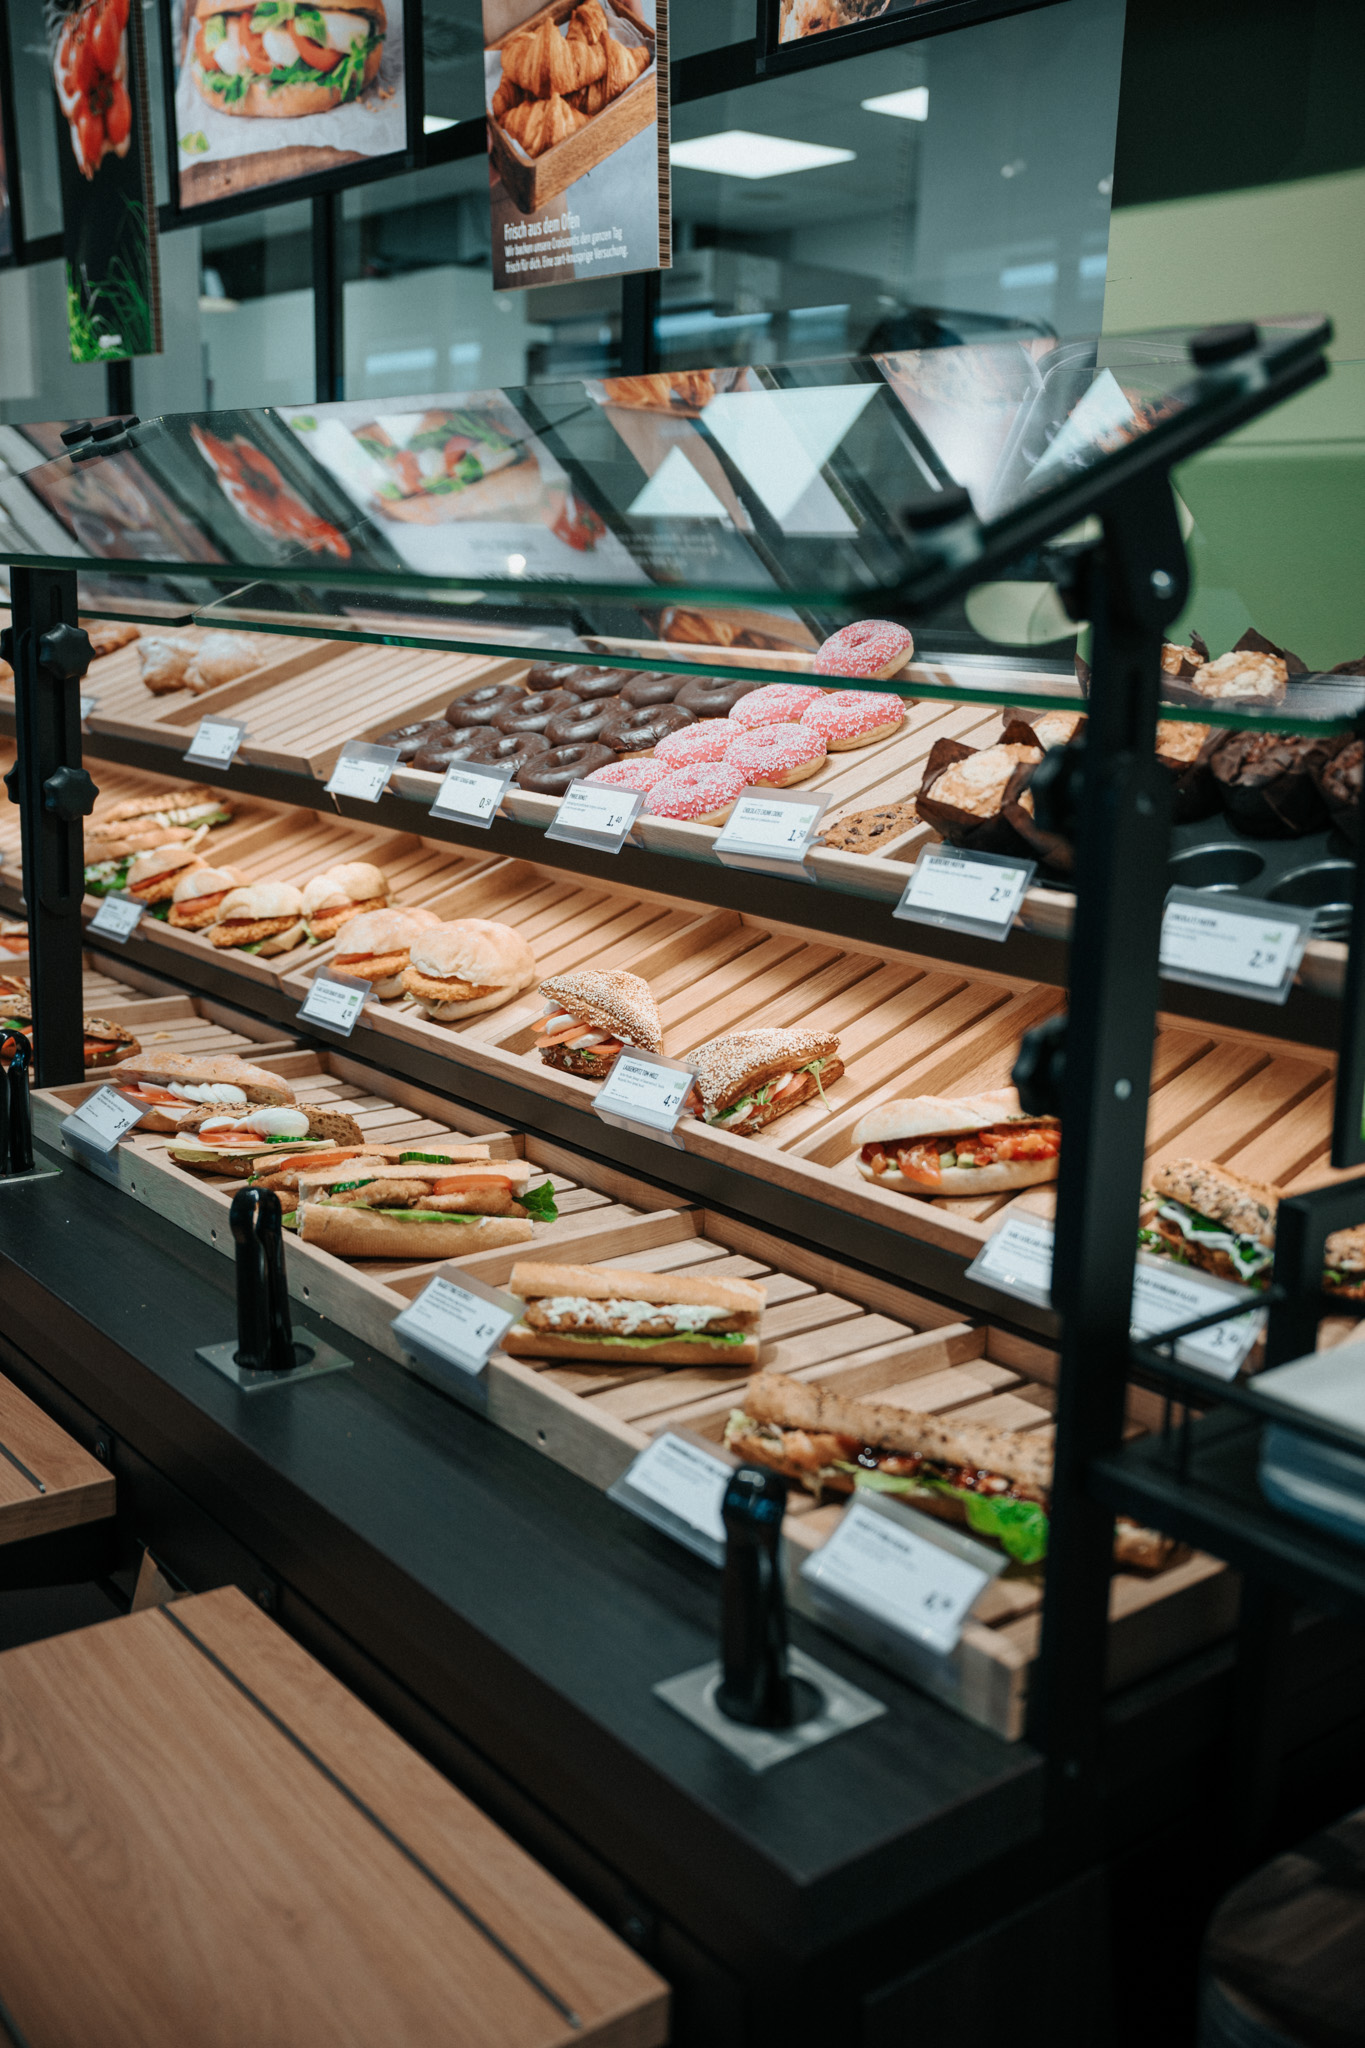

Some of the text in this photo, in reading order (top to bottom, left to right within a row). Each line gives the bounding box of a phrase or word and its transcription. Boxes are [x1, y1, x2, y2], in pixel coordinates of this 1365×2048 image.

[503, 211, 580, 241] Frisch aus dem Ofen
[504, 226, 623, 257] Wir backen unsere Croissants den ganzen Tag
[505, 244, 629, 273] frisch für dich. Eine zart-knusprige Versuchung.
[479, 797, 492, 809] 0.50
[606, 815, 623, 827] 1.40
[787, 829, 807, 842] 1.50
[663, 1094, 681, 1107] 4.20
